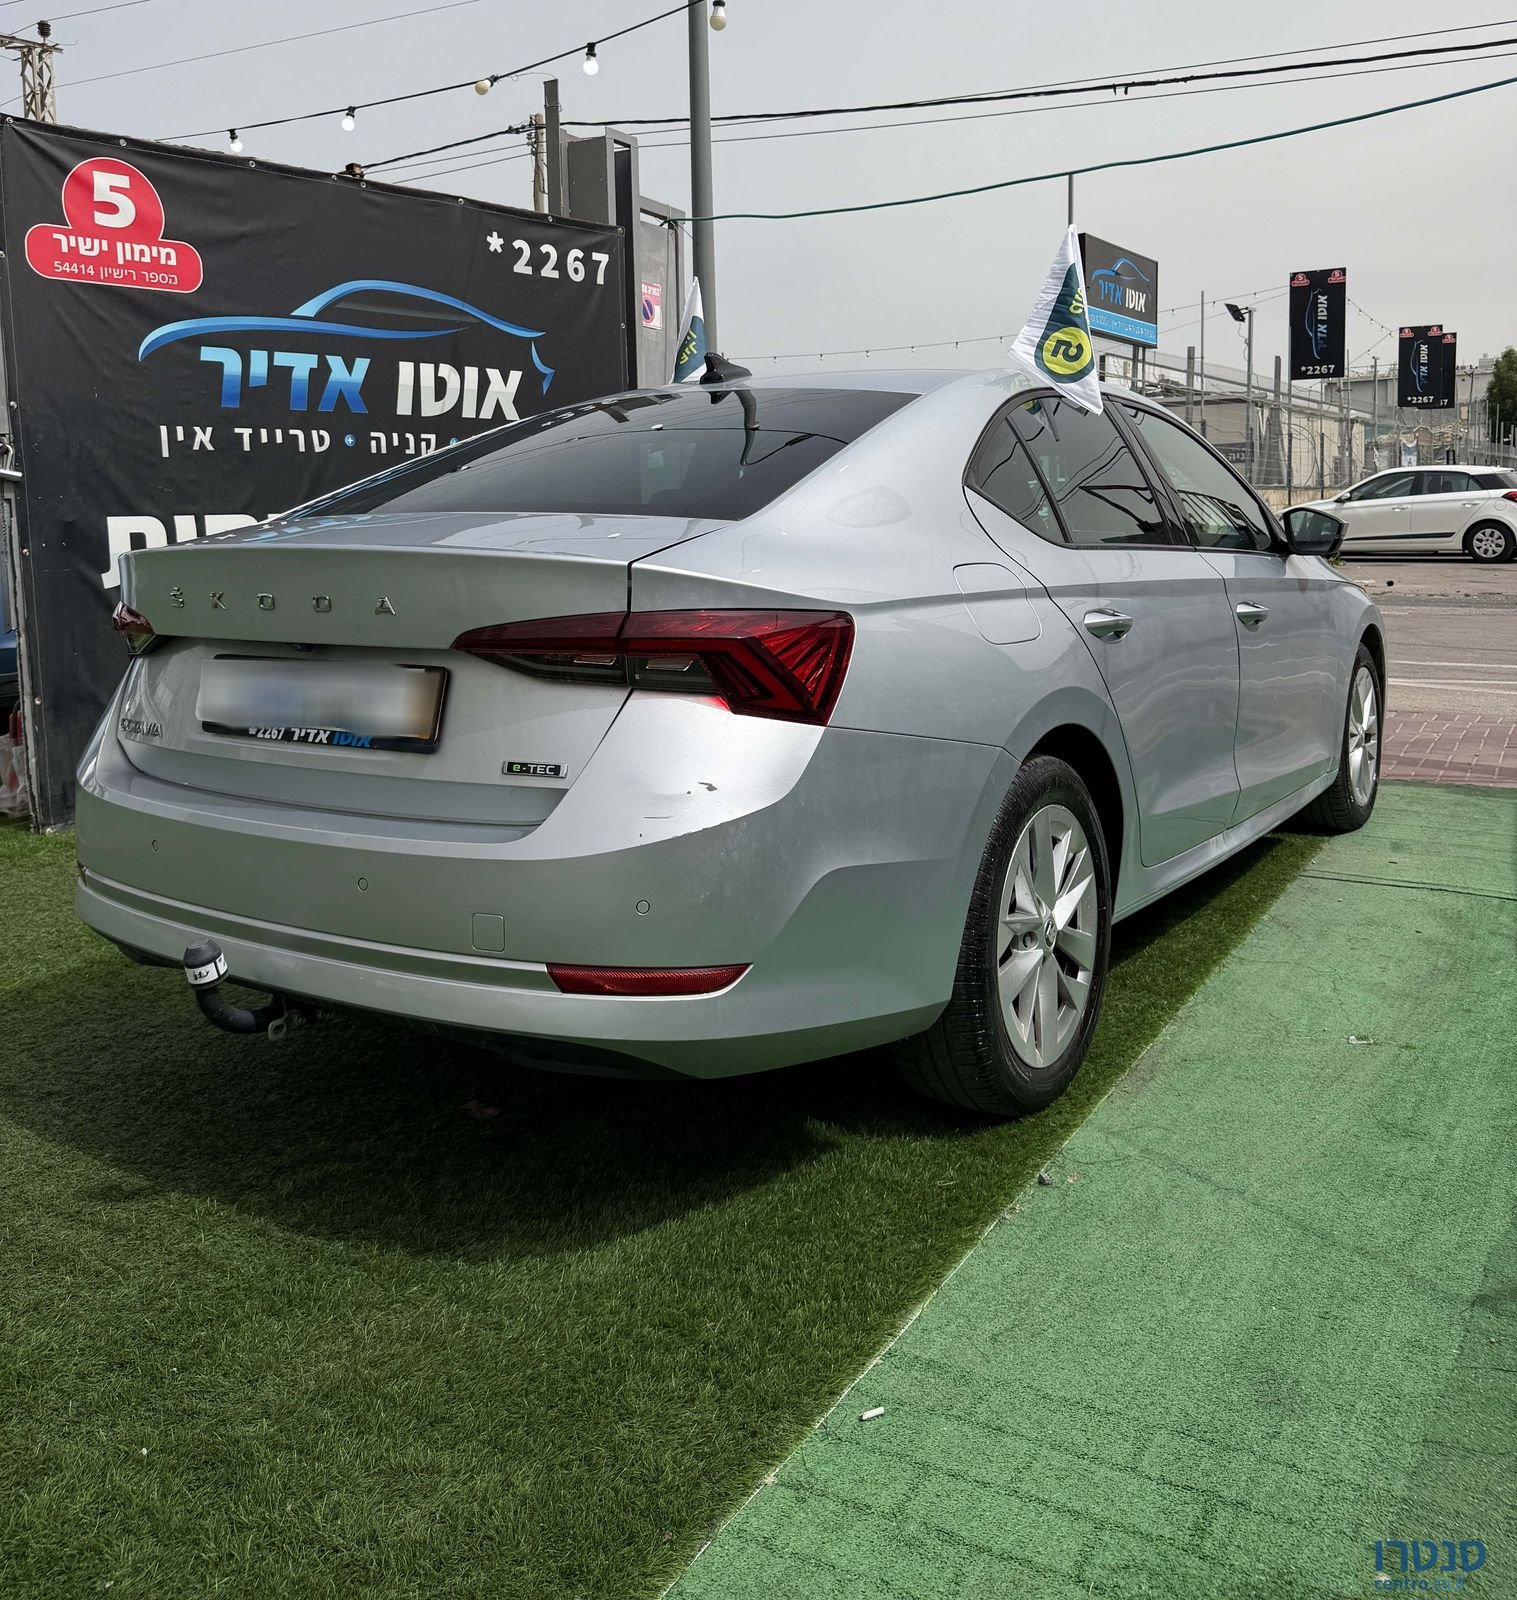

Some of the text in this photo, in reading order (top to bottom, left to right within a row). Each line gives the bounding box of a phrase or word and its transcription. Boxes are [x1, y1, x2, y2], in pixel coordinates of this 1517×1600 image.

[93, 170, 136, 228] 5
[53, 233, 177, 266] מימון ישיר
[54, 260, 178, 285] מספר רישיון 54414
[1098, 279, 1123, 306] אדיר
[1125, 287, 1146, 313] אוטו
[200, 345, 523, 421] אוטו אדיר
[160, 425, 437, 457] קניה טרייד אין
[290, 727, 332, 744] אדיר
[512, 764, 556, 775] e-TEC
